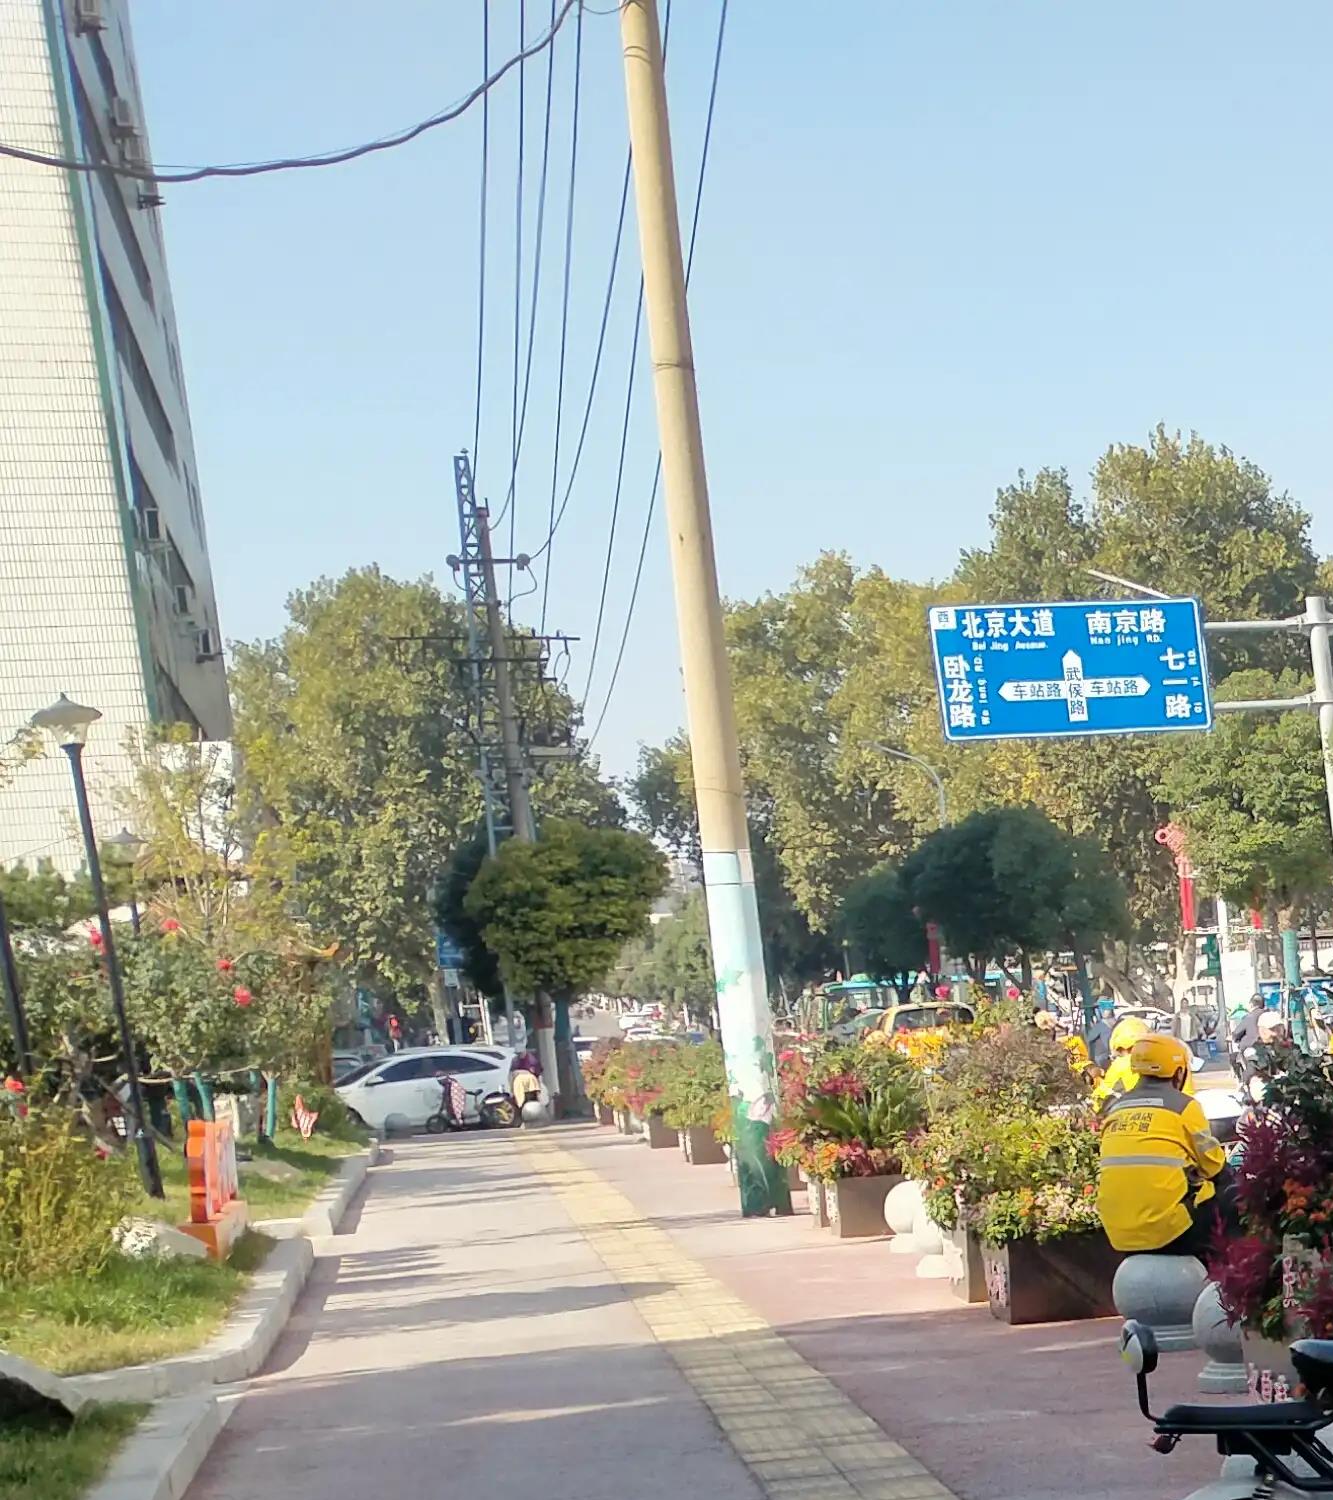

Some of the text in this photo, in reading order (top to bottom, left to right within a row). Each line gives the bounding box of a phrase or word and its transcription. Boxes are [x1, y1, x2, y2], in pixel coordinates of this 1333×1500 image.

[961, 608, 1166, 639] 北京大道 南京路
[943, 654, 976, 728] 卧龙路
[1013, 679, 1139, 698] 车站路 车站路
[1065, 667, 1085, 715] 武侯路
[1159, 648, 1191, 718] 七一路
